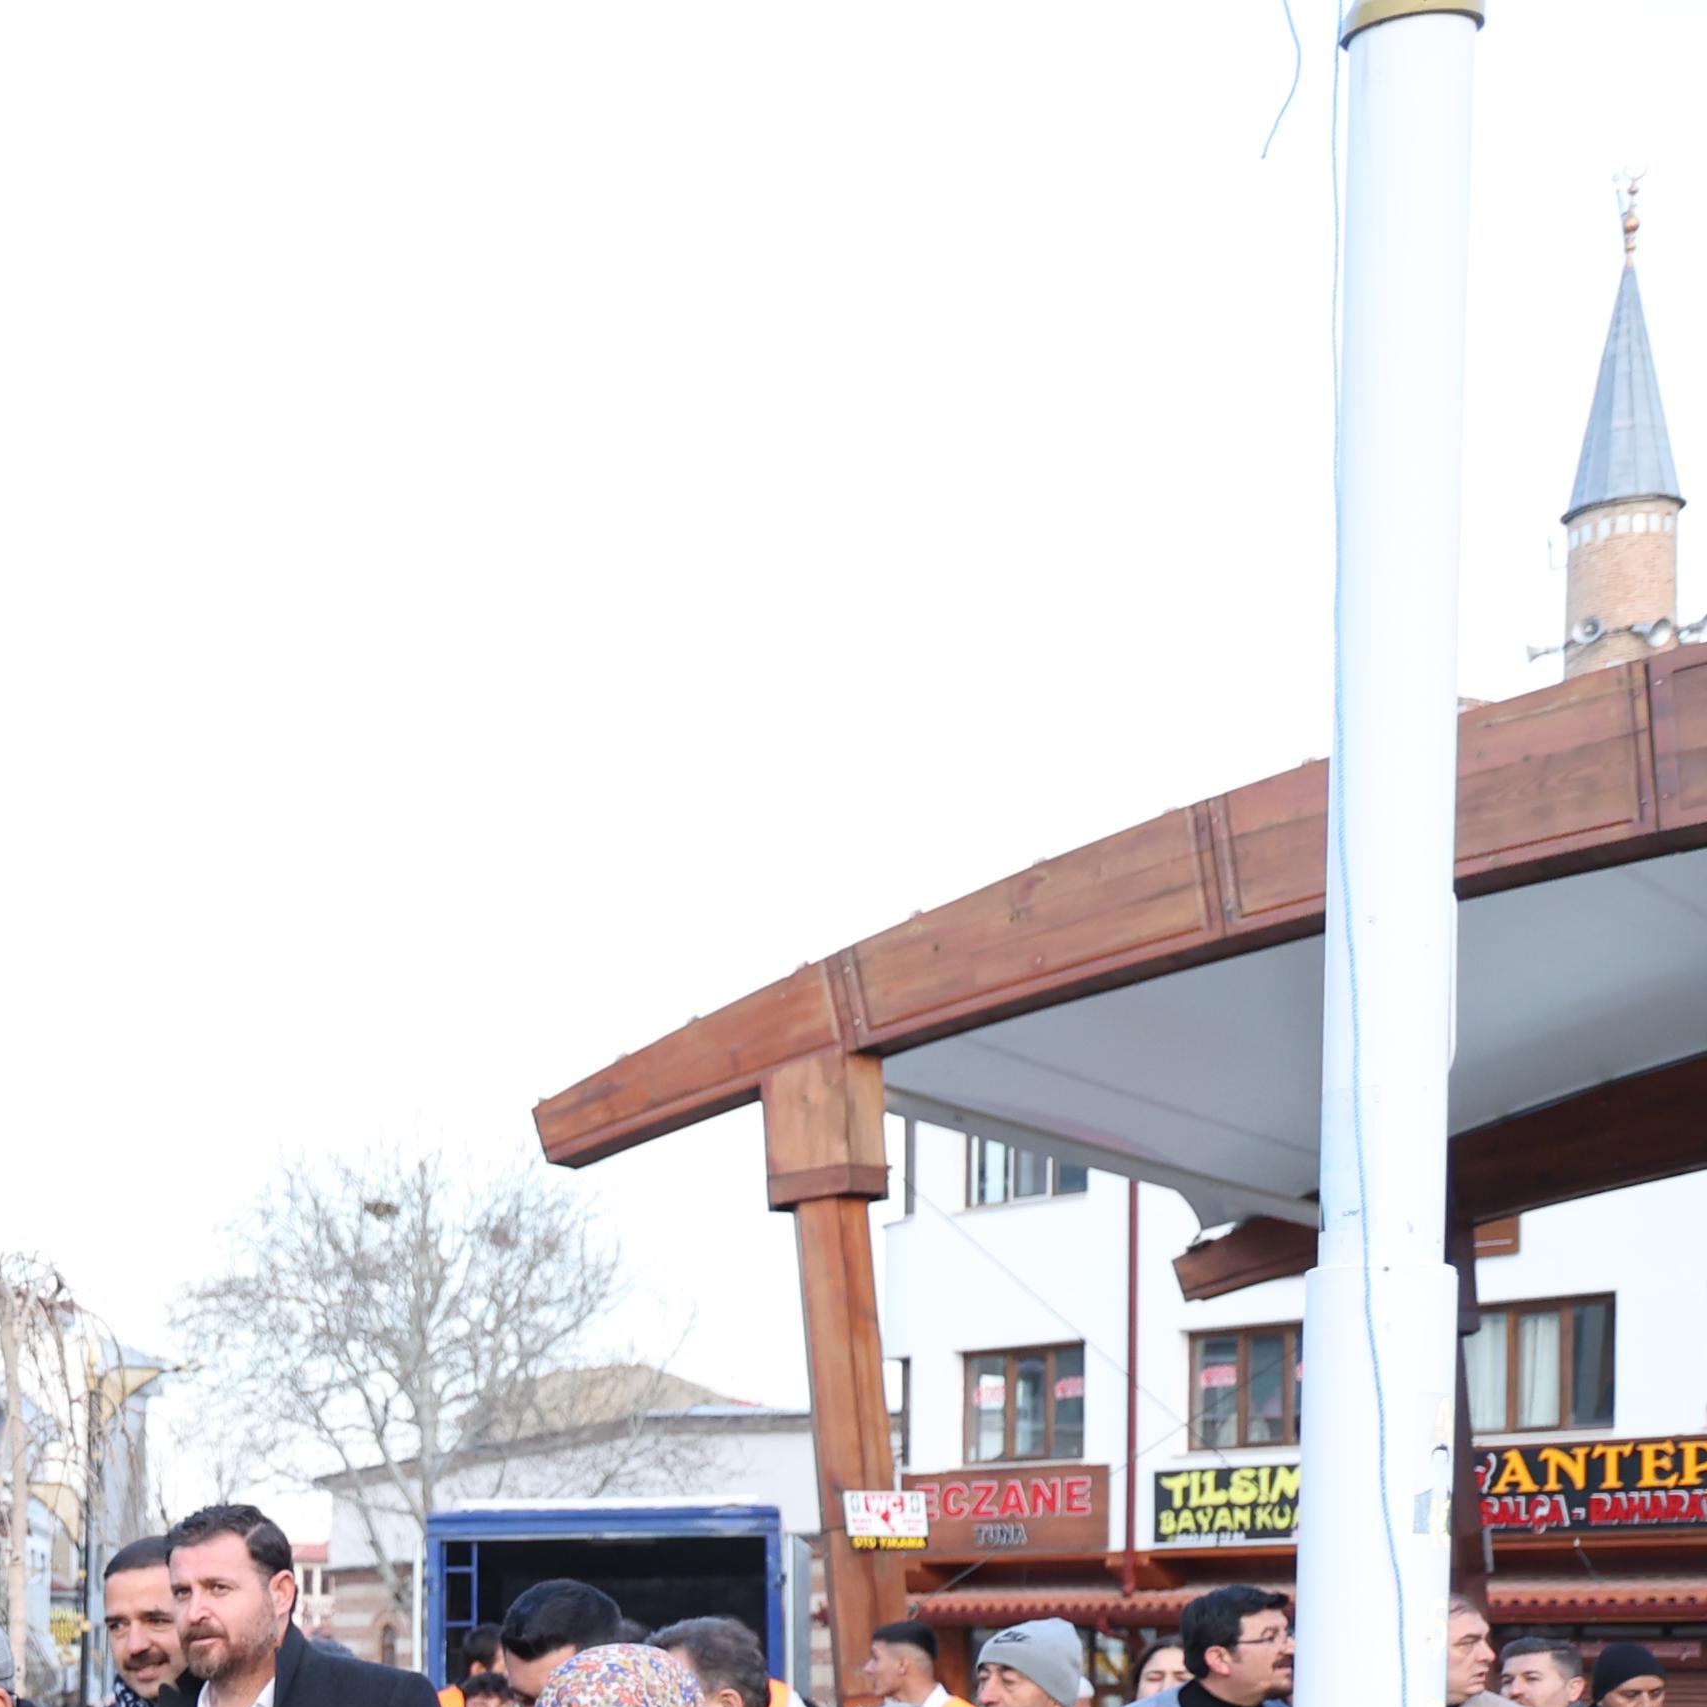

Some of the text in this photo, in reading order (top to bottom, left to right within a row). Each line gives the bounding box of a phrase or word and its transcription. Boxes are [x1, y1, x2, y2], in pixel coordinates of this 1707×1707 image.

[866, 1493, 901, 1514] WC
[915, 1475, 1092, 1521] ECZANE
[1159, 1506, 1252, 1535] BAYAN
[974, 1523, 1028, 1546] TUNA
